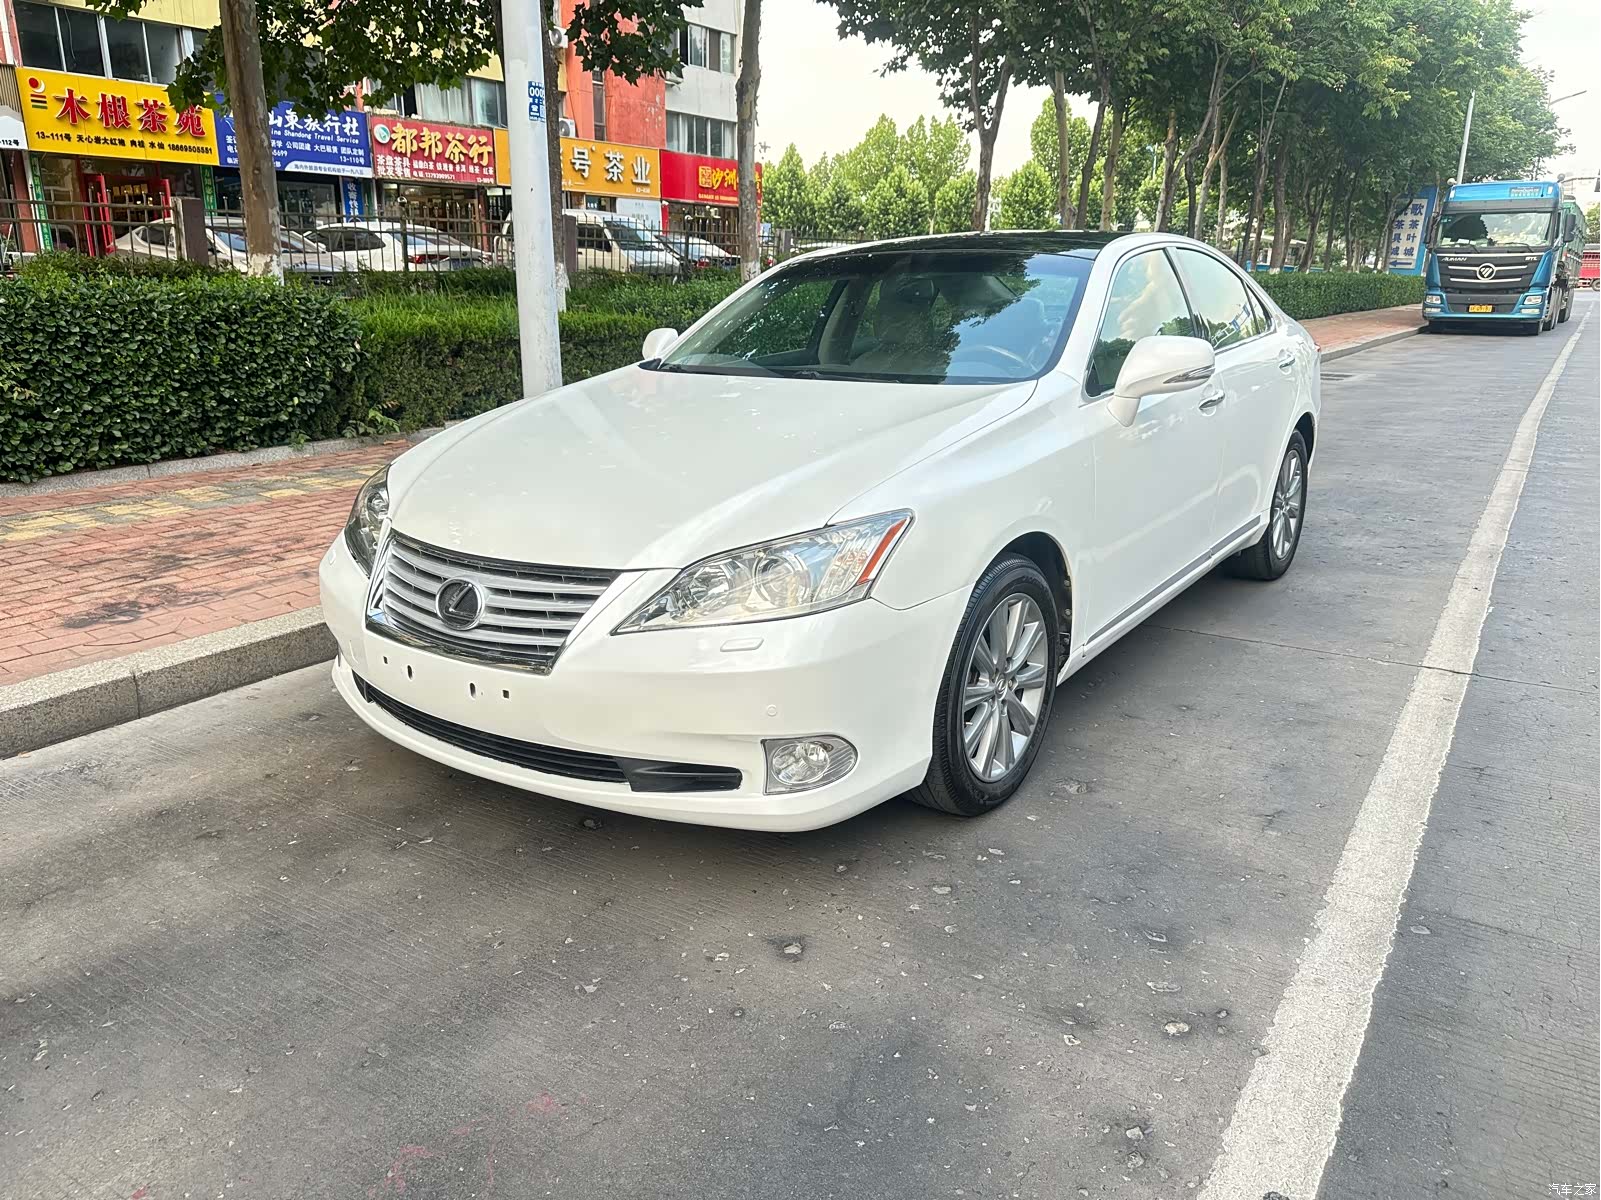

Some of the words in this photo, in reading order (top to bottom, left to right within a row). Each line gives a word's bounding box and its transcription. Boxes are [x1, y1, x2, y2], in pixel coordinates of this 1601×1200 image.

[53, 88, 206, 138] 木根茶苑
[36, 131, 72, 142] 13-111号
[148, 141, 165, 150] 水仙
[284, 130, 312, 139] Shandong
[314, 133, 334, 141] Travel
[336, 135, 359, 144] Service
[391, 122, 493, 166] 都邦茶行
[339, 155, 365, 165] 13-110号
[560, 144, 652, 185] 号茶业
